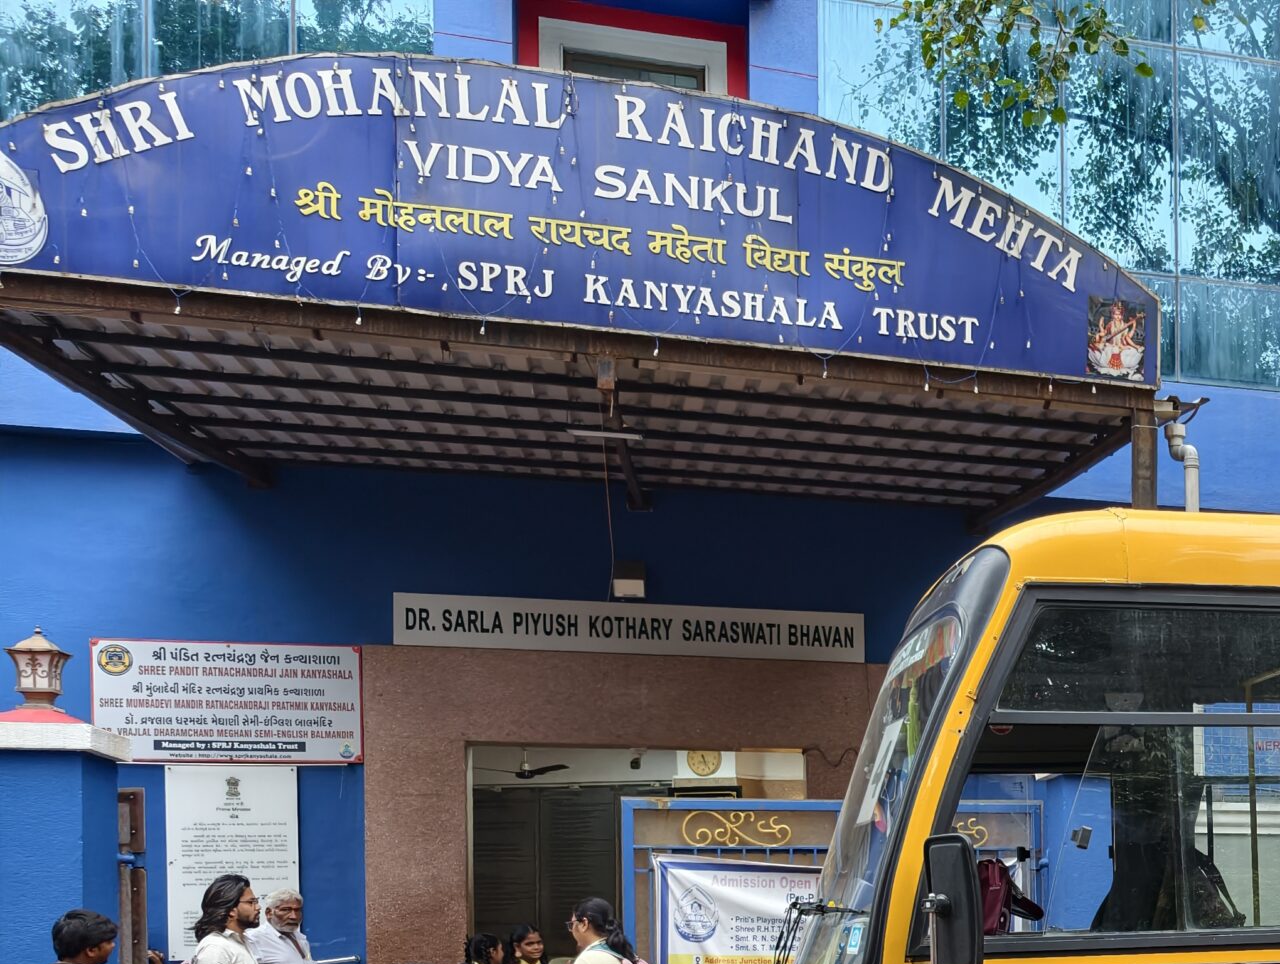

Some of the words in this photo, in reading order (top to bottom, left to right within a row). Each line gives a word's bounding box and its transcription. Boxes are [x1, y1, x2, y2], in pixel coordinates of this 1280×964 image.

[43, 91, 195, 174] SHRI
[232, 67, 567, 130] MOHANLAL
[614, 94, 893, 193] RAICHAND
[927, 175, 1083, 294] MEHTA
[403, 139, 564, 193] VIDYA
[594, 164, 793, 225] SANKUL
[293, 180, 342, 221] श्री
[358, 188, 515, 241] मोहनलाल
[647, 223, 728, 266] महेता
[742, 233, 811, 277] विद्या
[823, 246, 906, 293] संकुल
[190, 233, 351, 284] Managed
[457, 260, 556, 299] SPRJ
[583, 272, 844, 331] KANYASHALA
[872, 306, 980, 346] TRUST
[404, 607, 436, 632] DR.
[441, 608, 504, 634] SARLA
[512, 611, 579, 638] PIYUSH
[588, 615, 673, 641] KOTHARY
[681, 618, 782, 647] SARASWATI
[788, 623, 855, 649] BHAVAN
[151, 646, 167, 661] શ્રી
[169, 647, 200, 663] પંડિત
[260, 648, 280, 664] જૈન
[283, 653, 341, 666] કન્યાશાળા
[138, 664, 167, 676] SHREE
[168, 665, 200, 677] PANDIT
[202, 666, 277, 679] RATNACHANDRAJI
[279, 668, 298, 679] JAIN
[300, 669, 354, 681] KANYASHALA
[131, 681, 143, 695] શ્રી
[145, 681, 180, 698] મુંબાદેવી
[181, 682, 203, 696] મંદિર
[247, 684, 280, 697] પ્રાથમિક
[282, 686, 325, 698] કન્યાશાળા
[99, 697, 124, 708] SHREE
[125, 698, 173, 710] MUMBADEVI
[174, 699, 204, 710] MANDIR
[205, 699, 270, 711] RATNACHANDRAJI
[271, 700, 309, 712] PRATHMIK
[310, 701, 356, 713] KANYASHALA
[294, 715, 334, 728] બાલમંદિર
[117, 727, 152, 738] VRAJLAL
[153, 728, 215, 738] DHARAMCHAND
[216, 728, 253, 739] MEGHANI
[253, 729, 309, 740] SEMI-ENGLISH
[310, 730, 355, 740] BALMANDIR
[161, 741, 196, 750] Managed
[196, 741, 207, 750] by
[211, 741, 233, 750] SPRJ
[233, 742, 277, 751] Kanyashala
[277, 742, 299, 750] Trust
[711, 874, 776, 889] Admission
[779, 876, 812, 892] Open
[735, 925, 756, 933] Shree
[704, 956, 738, 964] Address:
[739, 957, 772, 964] Junction
